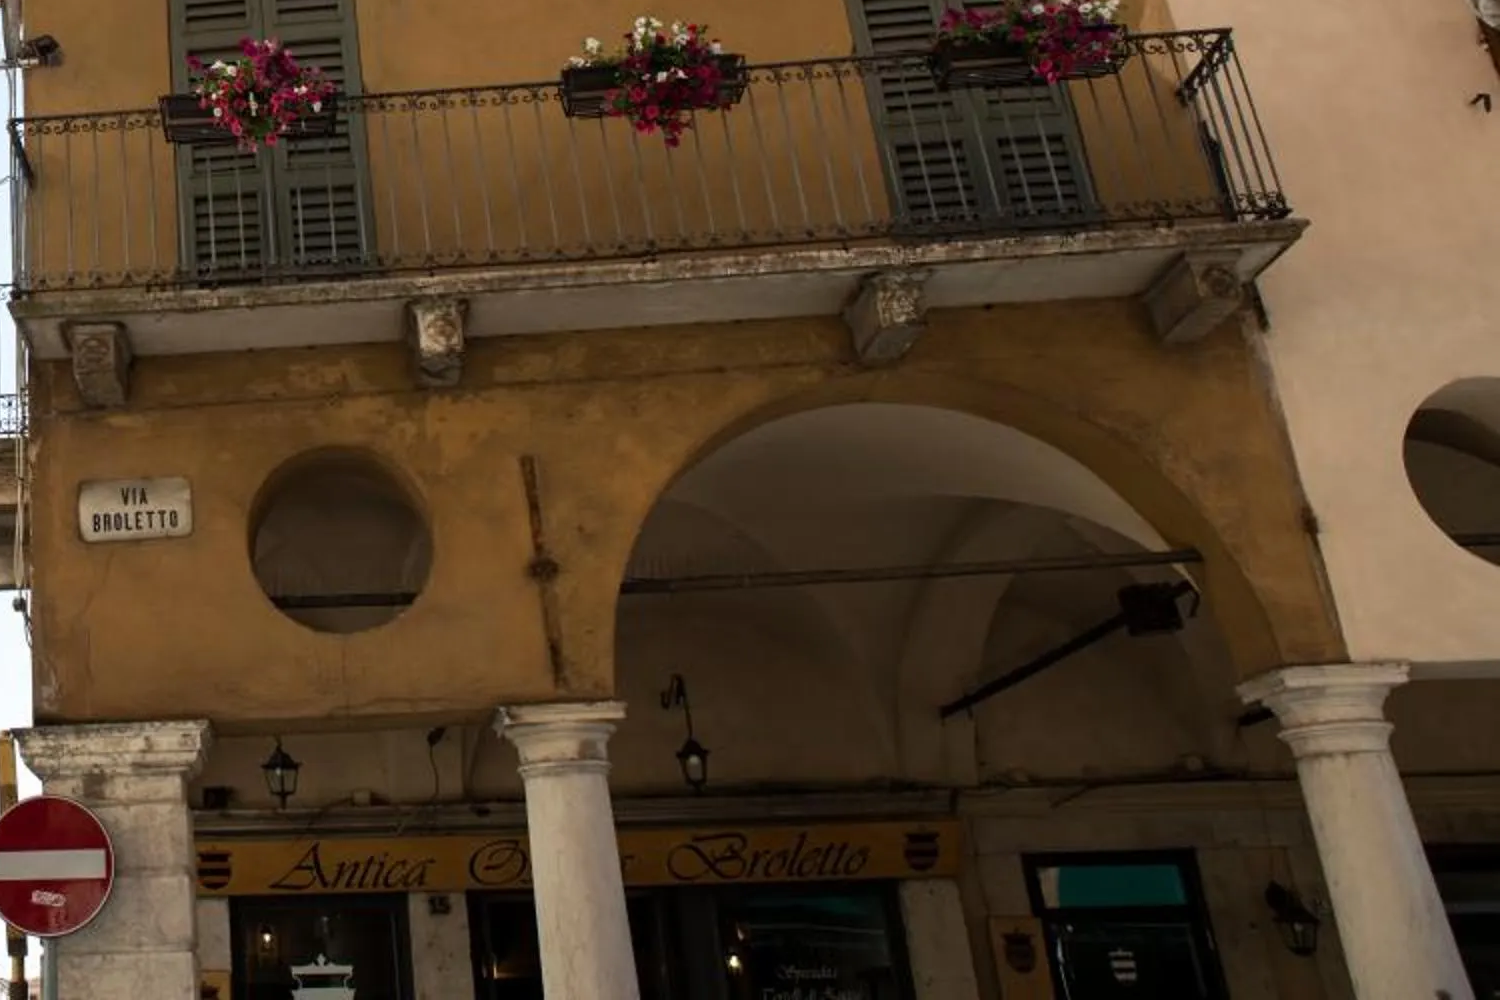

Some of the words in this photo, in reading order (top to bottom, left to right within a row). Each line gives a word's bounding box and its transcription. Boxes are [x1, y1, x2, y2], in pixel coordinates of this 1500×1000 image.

[121, 487, 148, 506] VIA
[92, 510, 179, 533] BROLETTO
[268, 839, 436, 890] Antica
[666, 831, 871, 882] Broletto
